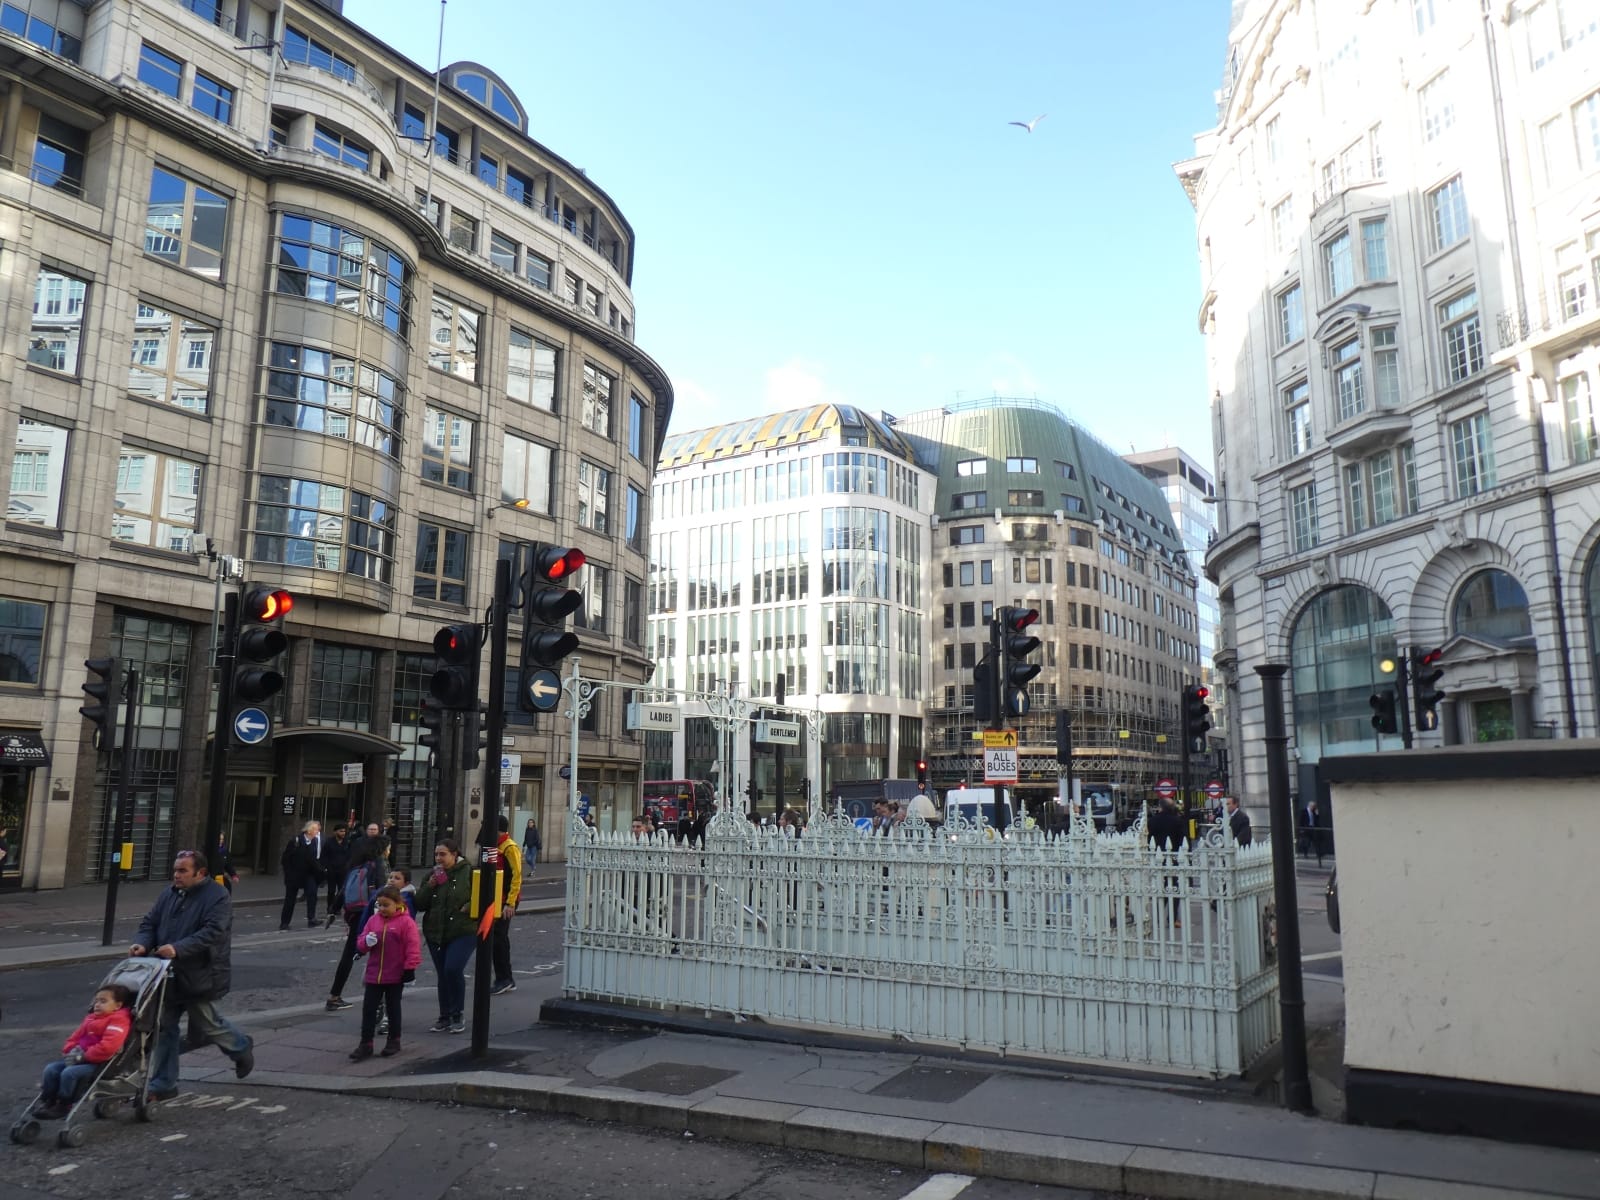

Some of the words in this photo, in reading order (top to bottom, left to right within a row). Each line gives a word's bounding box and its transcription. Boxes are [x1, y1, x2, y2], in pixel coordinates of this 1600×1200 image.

[650, 711, 673, 723] LADIES
[770, 727, 797, 738] GENTLEMEN
[993, 752, 1010, 761] ALL
[987, 762, 1016, 772] BUSES
[283, 796, 295, 805] 55
